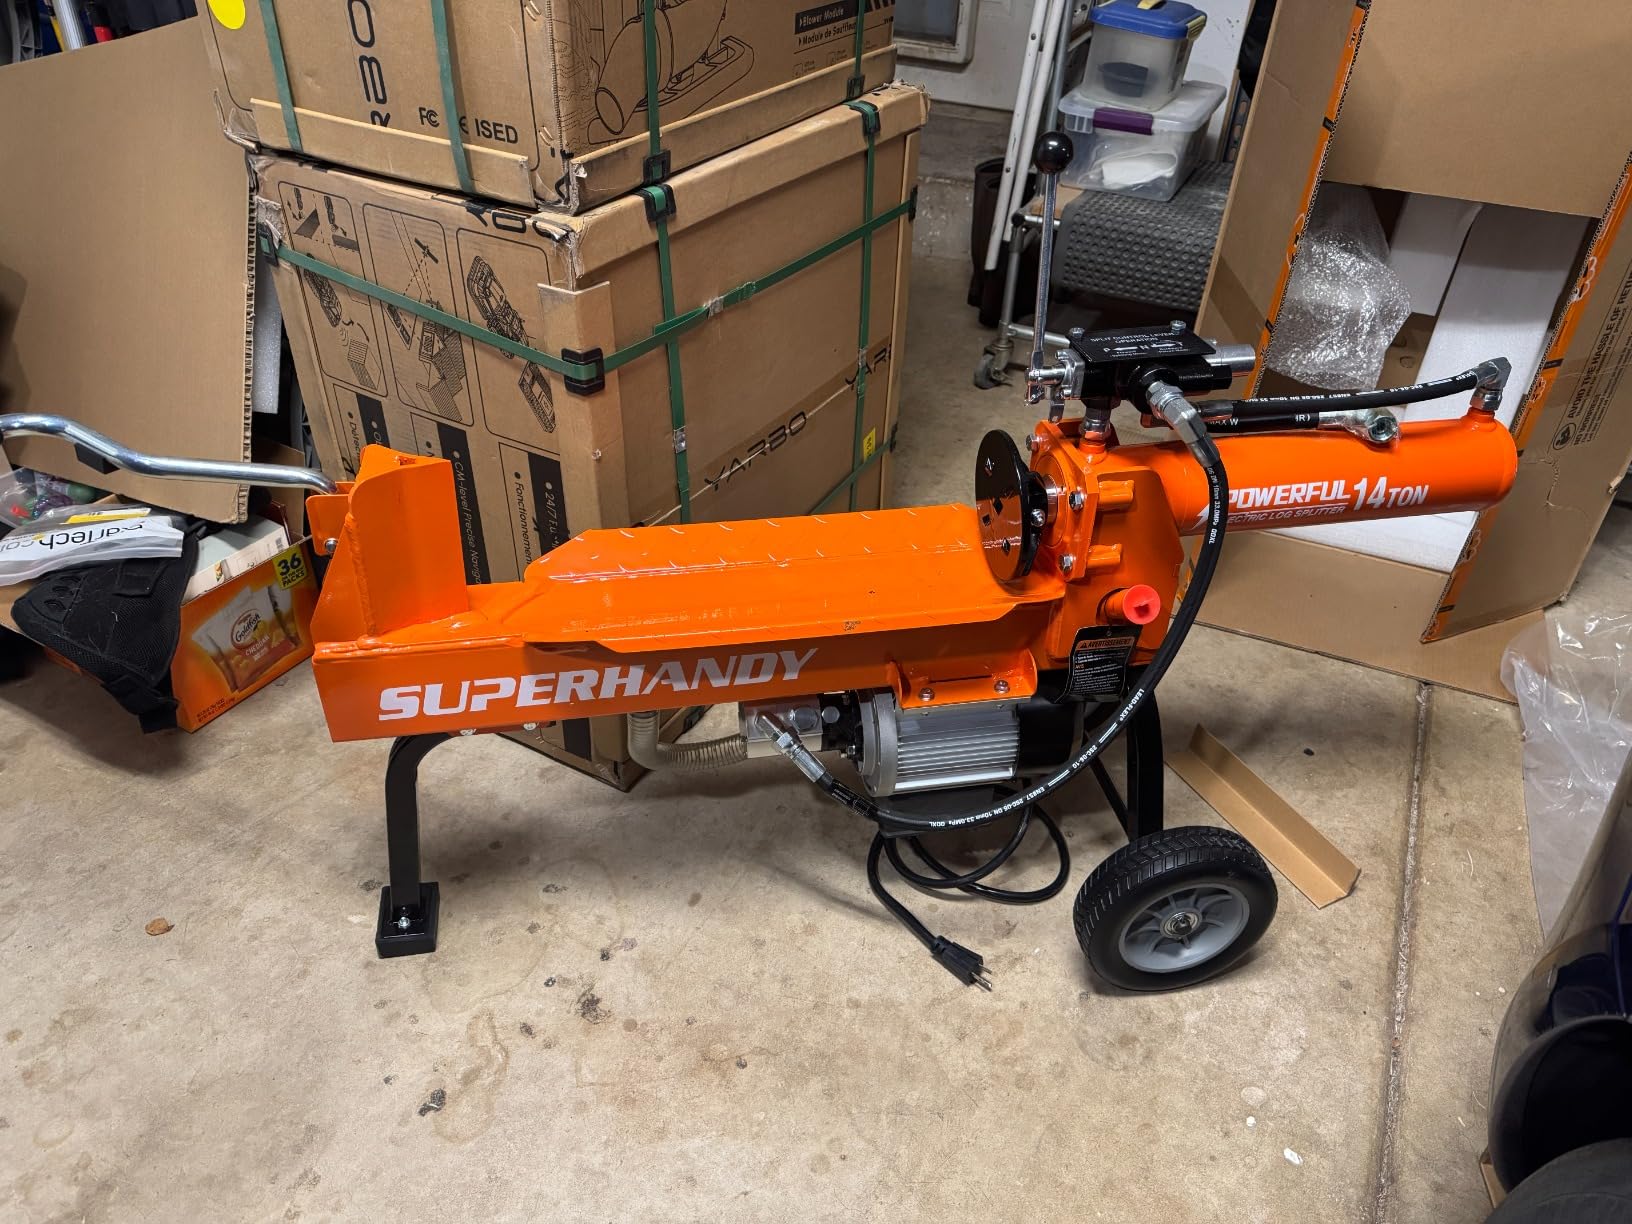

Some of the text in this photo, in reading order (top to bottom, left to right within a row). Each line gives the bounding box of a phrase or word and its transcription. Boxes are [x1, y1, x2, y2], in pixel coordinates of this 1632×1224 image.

[802, 7, 844, 26] Blower Module
[475, 118, 518, 144] ISED
[1567, 387, 1586, 419] AVOID
[1582, 361, 1597, 387] THE
[1591, 322, 1616, 369] HASSLE
[1612, 305, 1622, 324] OF
[704, 411, 806, 491] YARBO
[454, 461, 470, 511] CM-level
[463, 513, 476, 548] Precise
[544, 491, 557, 522] 24/7
[1353, 476, 1430, 511] 14 TON
[514, 481, 533, 565] Fonctionnemen
[1212, 500, 1221, 526] 33.0MPa
[1227, 506, 1346, 524] ECTRIC LOG SPLITTER
[277, 553, 302, 577] 36
[282, 571, 305, 587] PACKS
[235, 612, 261, 642] Goldfish
[245, 634, 270, 656] CHEDDAR
[378, 648, 819, 721] SUPERHANDY
[1026, 786, 1045, 801] EN857
[975, 812, 993, 820] 10mm
[993, 807, 1003, 815] DN
